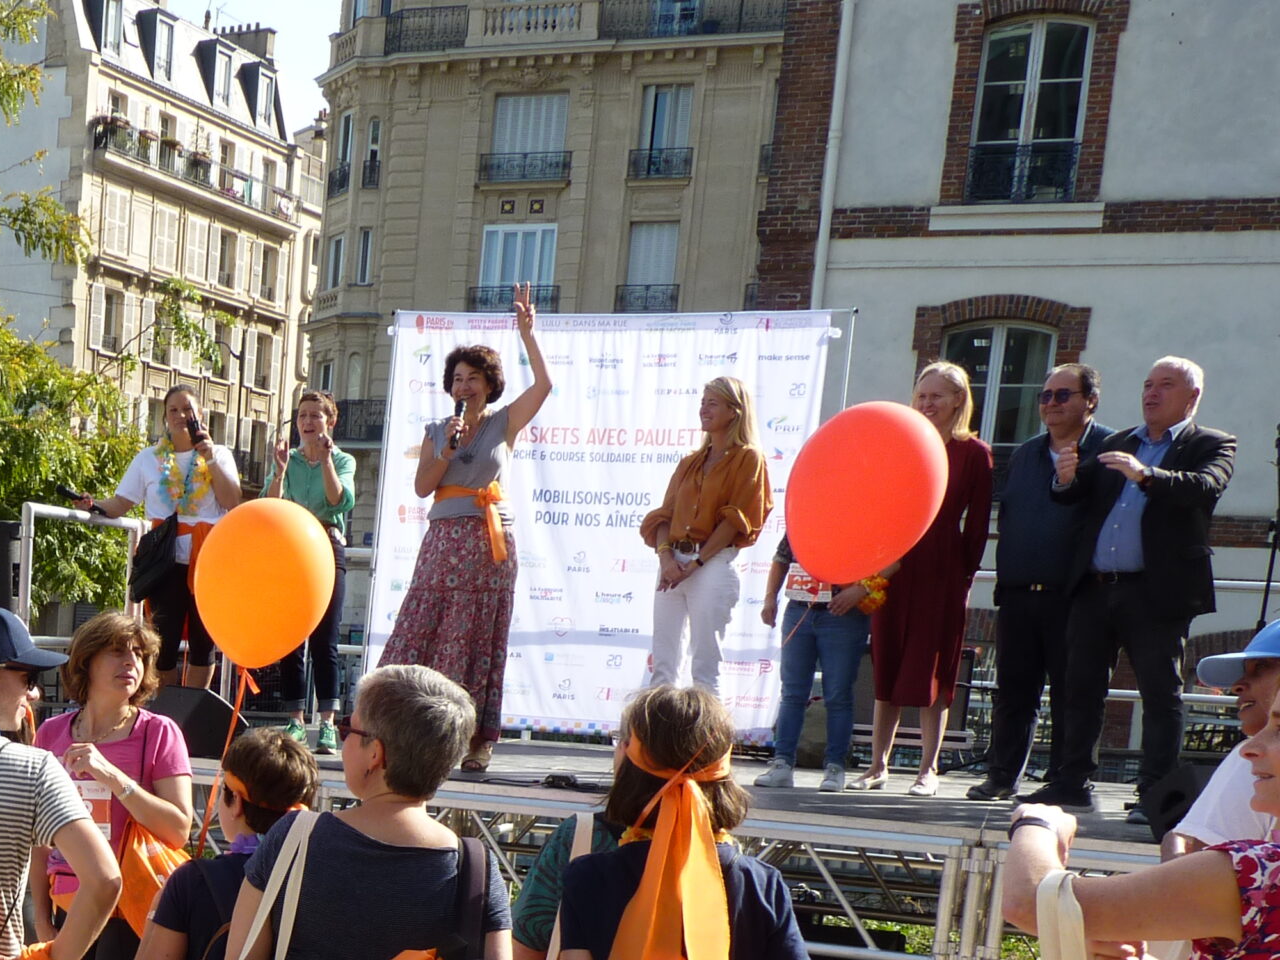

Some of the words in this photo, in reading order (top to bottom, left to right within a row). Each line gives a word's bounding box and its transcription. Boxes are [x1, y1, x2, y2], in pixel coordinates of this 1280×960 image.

[758, 353, 783, 361] make
[518, 426, 580, 445] ASKETS
[586, 428, 627, 446] AVEC
[634, 428, 706, 447] PAULETT
[513, 449, 537, 460] RCHE
[540, 450, 547, 461] &
[549, 451, 586, 462] COURSE
[589, 452, 637, 463] SOLIDAIRE
[641, 453, 653, 463] EN
[532, 489, 651, 506] MOBILISONS-NOUS
[535, 511, 569, 525] POUR
[574, 512, 601, 527] NOS
[605, 510, 644, 528] AÎNÉS
